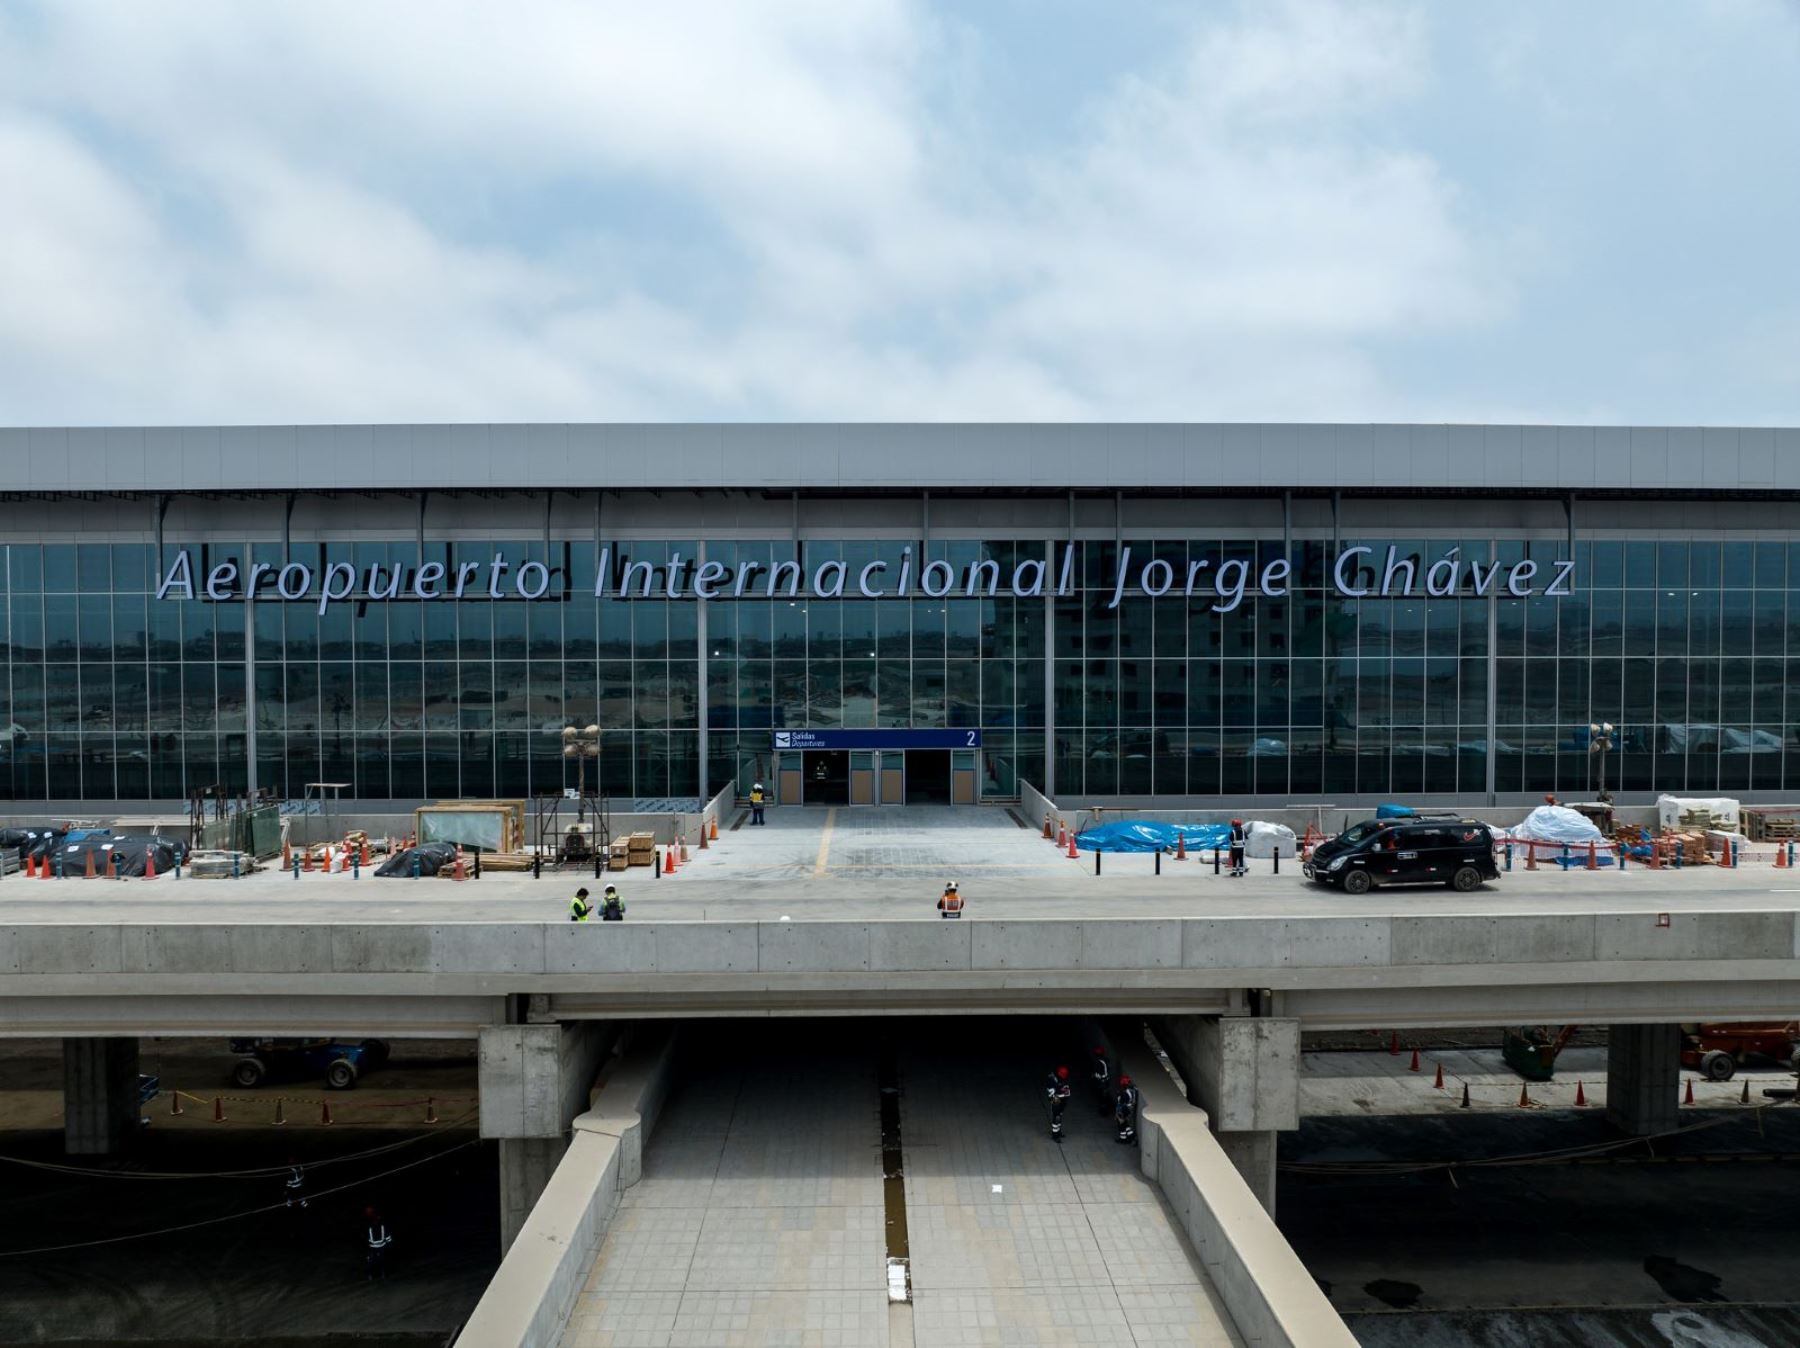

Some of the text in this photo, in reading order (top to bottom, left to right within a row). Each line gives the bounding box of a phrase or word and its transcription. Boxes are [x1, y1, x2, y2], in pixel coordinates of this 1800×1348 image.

[156, 544, 1576, 616] Aeropuerto Internacional Jorge Chávez
[791, 731, 816, 740] Salidas
[966, 730, 976, 747] 2
[791, 740, 826, 748] Departures
